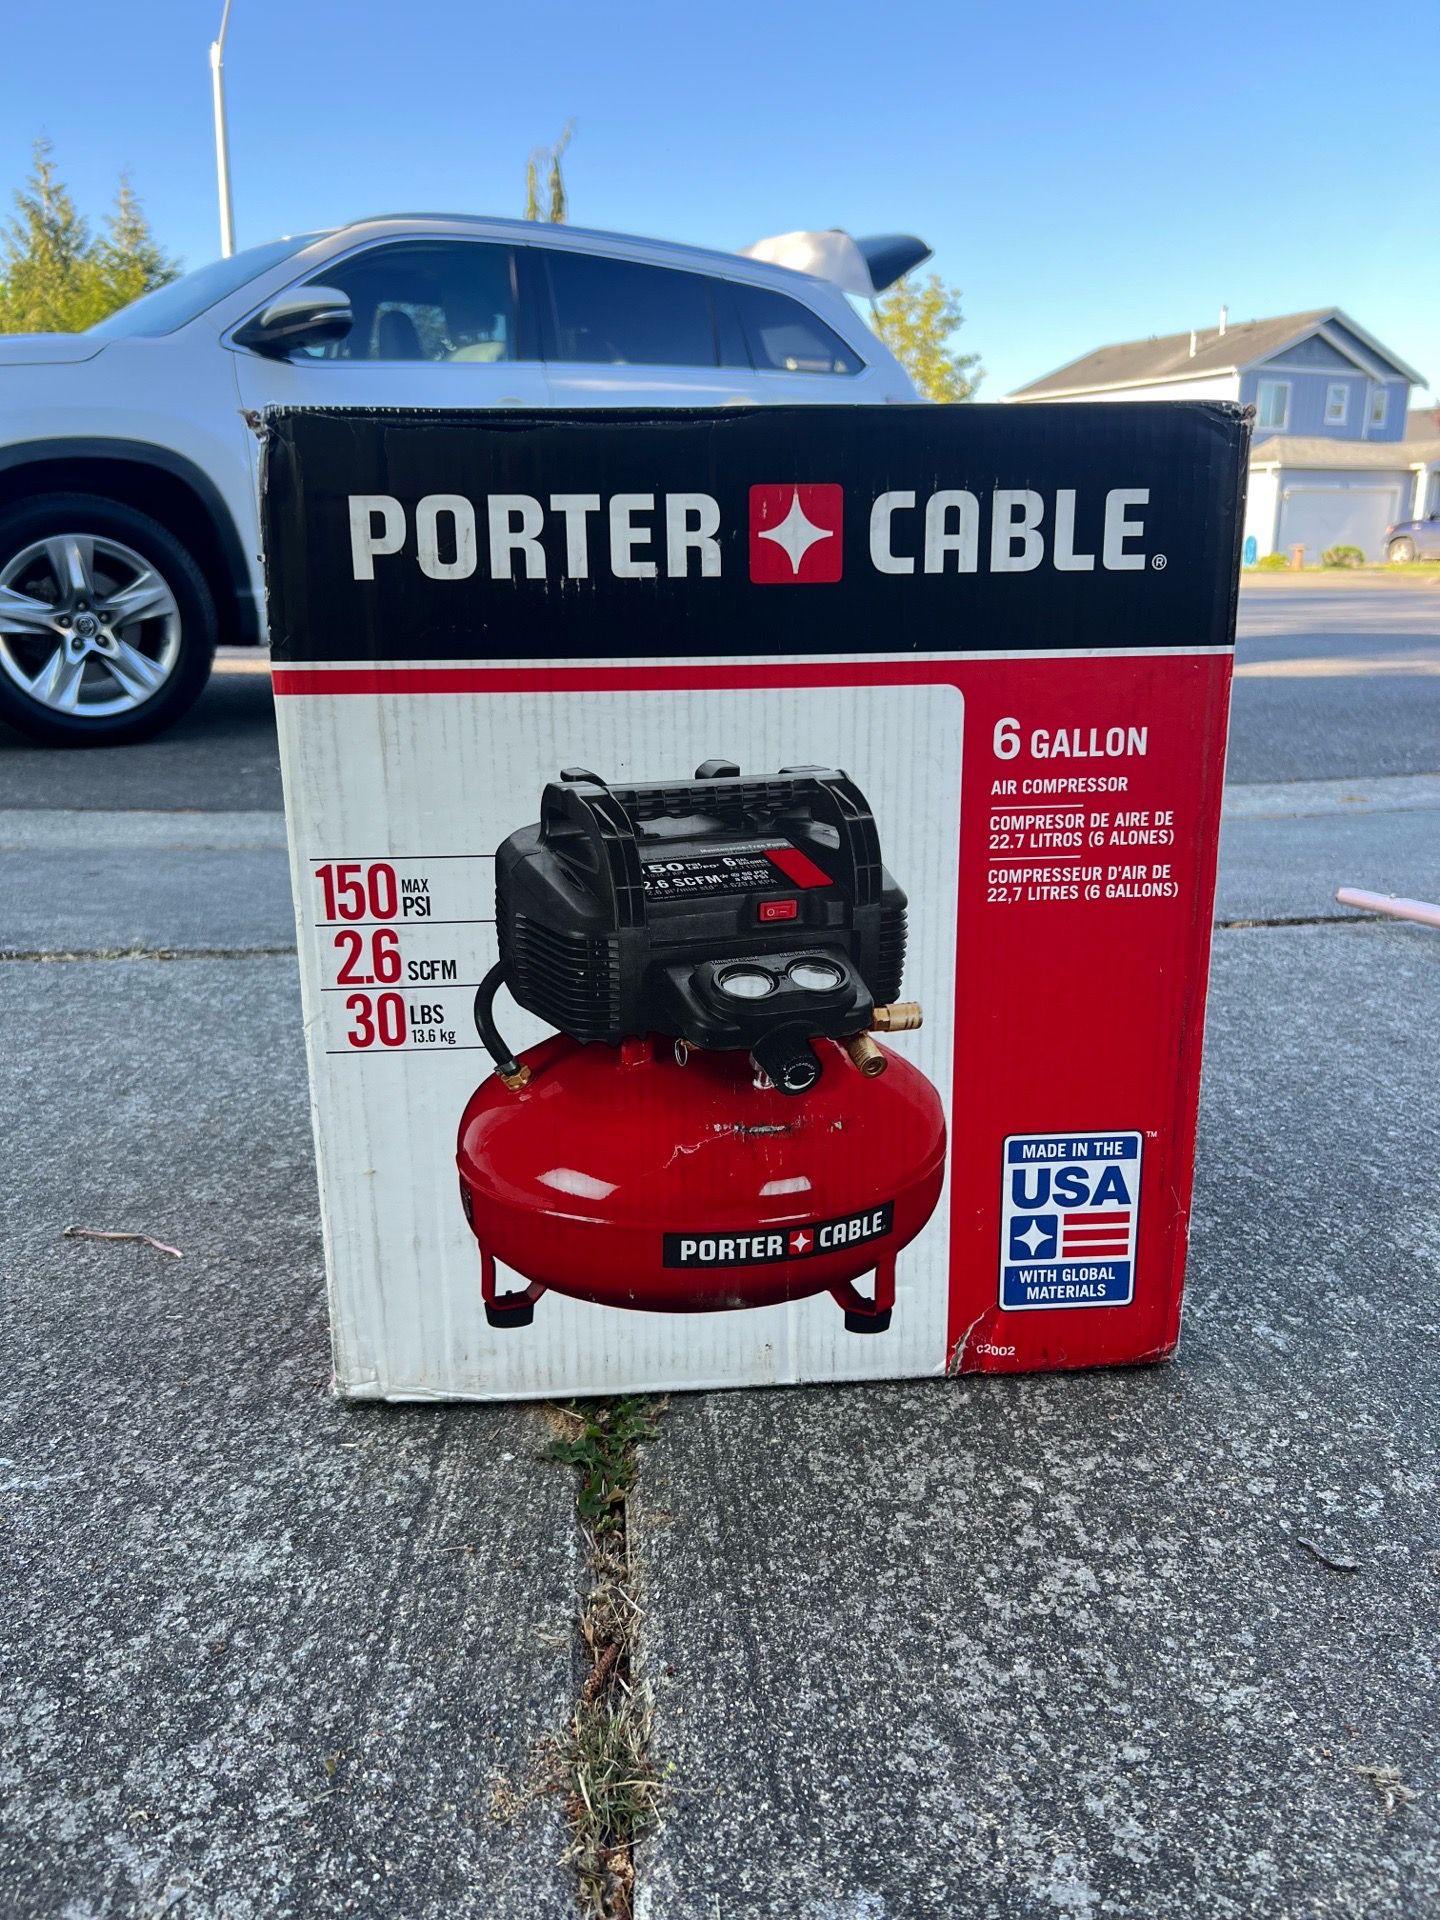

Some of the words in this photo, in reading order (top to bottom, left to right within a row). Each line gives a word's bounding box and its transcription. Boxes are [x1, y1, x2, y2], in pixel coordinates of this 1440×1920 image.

[348, 493, 722, 580] PORTER
[992, 717, 1021, 760] 6
[1030, 726, 1149, 759] GALLON
[991, 779, 1017, 796] AIR
[1022, 776, 1129, 795] COMPRESSOR
[989, 813, 1085, 831] COMPRESOR
[1090, 812, 1110, 828] DE
[1114, 811, 1150, 828] AIRE
[1154, 810, 1174, 826] DE
[989, 833, 1025, 850] 22.7
[1029, 831, 1083, 849] LITROS
[1088, 831, 1105, 848] (6
[1109, 829, 1175, 846] ALONES)
[722, 857, 737, 867] 6
[987, 866, 1103, 884] COMPRESSEUR
[1107, 864, 1148, 881] D'AIR
[1152, 863, 1172, 879] DE
[315, 862, 398, 921] 150
[401, 878, 430, 893] MAX
[643, 879, 670, 890] 2.6
[987, 886, 1023, 904] 22,7
[1028, 885, 1079, 902] LITRES
[1084, 884, 1101, 901] (6
[1105, 881, 1179, 899] GALLONS)
[402, 895, 432, 917] PSI
[333, 928, 402, 985] 2.6
[407, 959, 458, 981] SCFM
[346, 992, 408, 1048] 30
[410, 1004, 445, 1025] LBS
[411, 1029, 436, 1044] 13.6
[439, 1028, 456, 1045] kg
[1022, 1143, 1067, 1159] MADE
[1072, 1142, 1089, 1157] IN
[1093, 1141, 1124, 1156] THE
[1011, 1165, 1132, 1210] USA
[680, 1235, 783, 1261] PORTER
[1019, 1269, 1057, 1284] WITH
[1062, 1266, 1116, 1282] GLOBAL
[1026, 1283, 1107, 1300] MATERIALS
